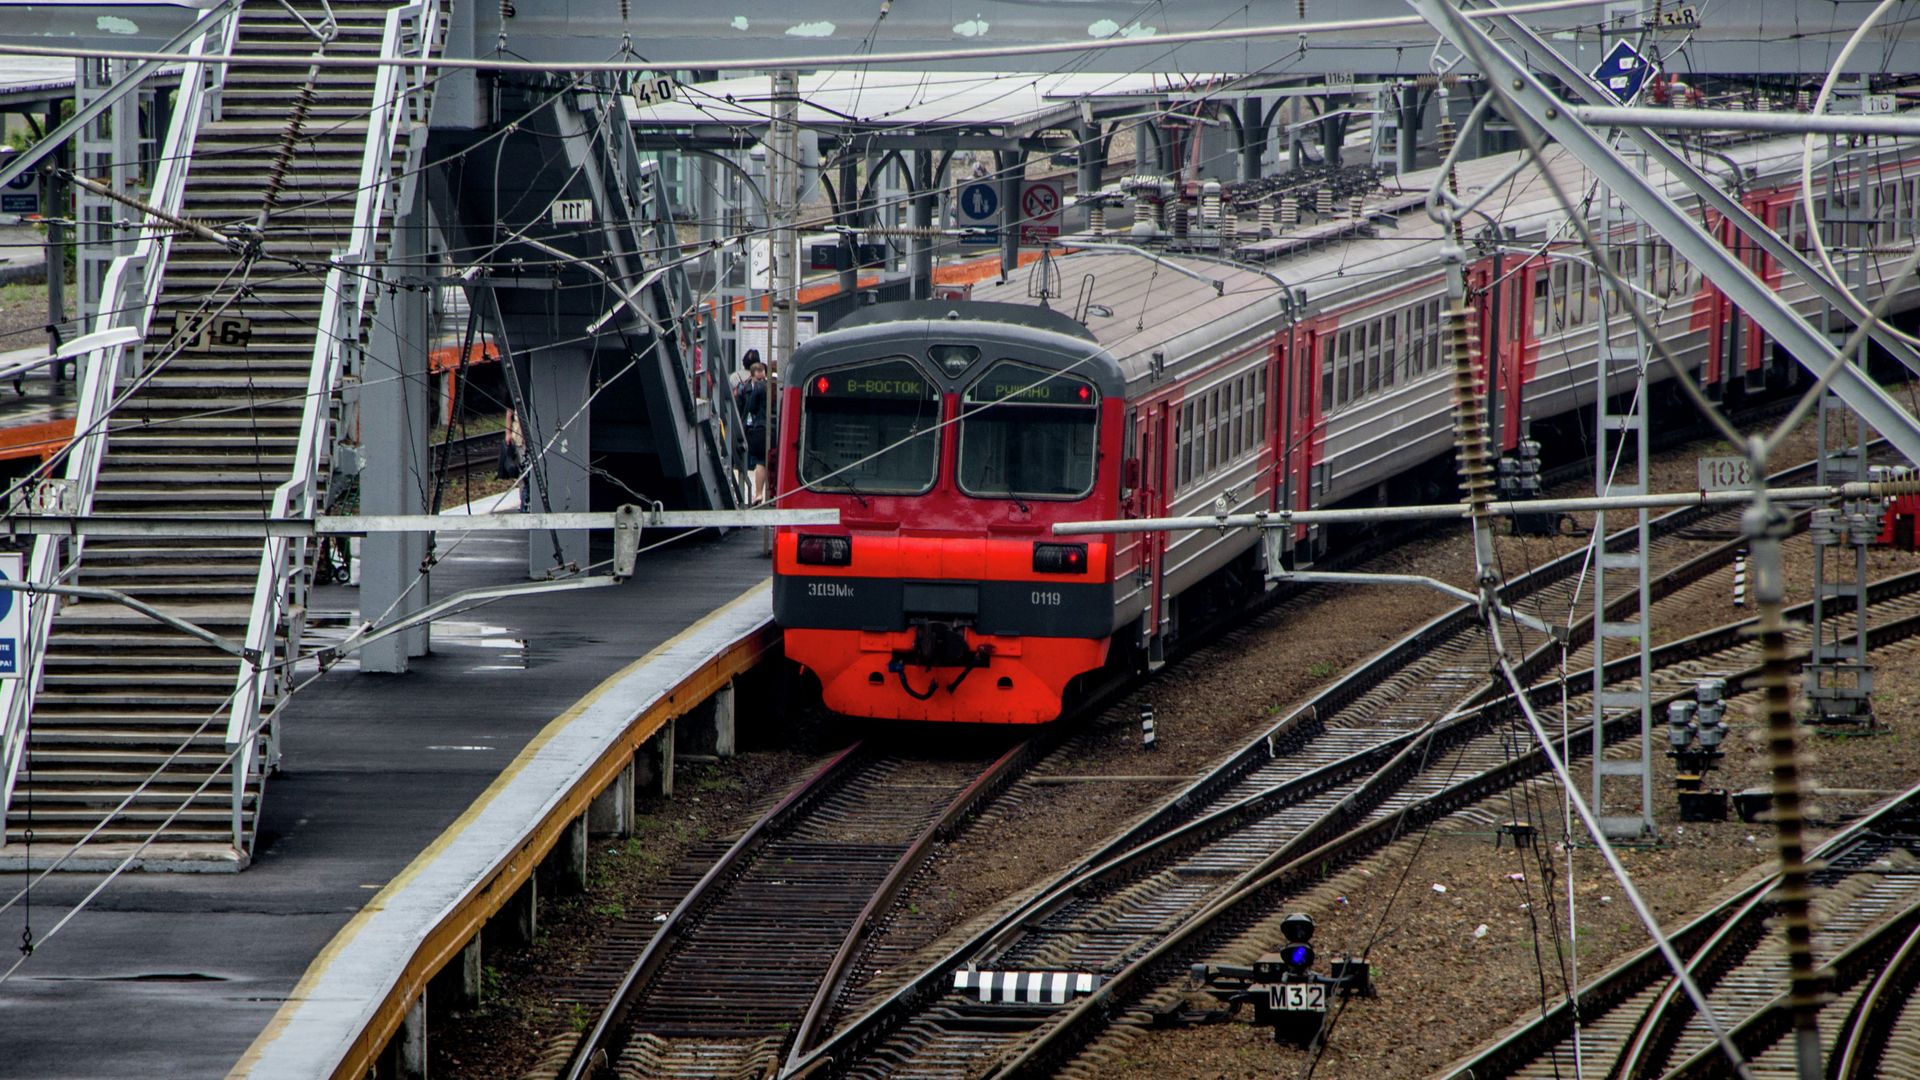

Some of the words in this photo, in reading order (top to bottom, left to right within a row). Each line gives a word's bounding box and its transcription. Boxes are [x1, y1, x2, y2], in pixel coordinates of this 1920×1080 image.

[1664, 8, 1695, 25] 3-8
[640, 79, 672, 103] 4-0
[819, 247, 828, 261] 5
[181, 316, 241, 346] 3-6
[847, 380, 920, 394] В-ВОСТОК
[1708, 461, 1751, 487] 108
[1031, 591, 1061, 605] 0119
